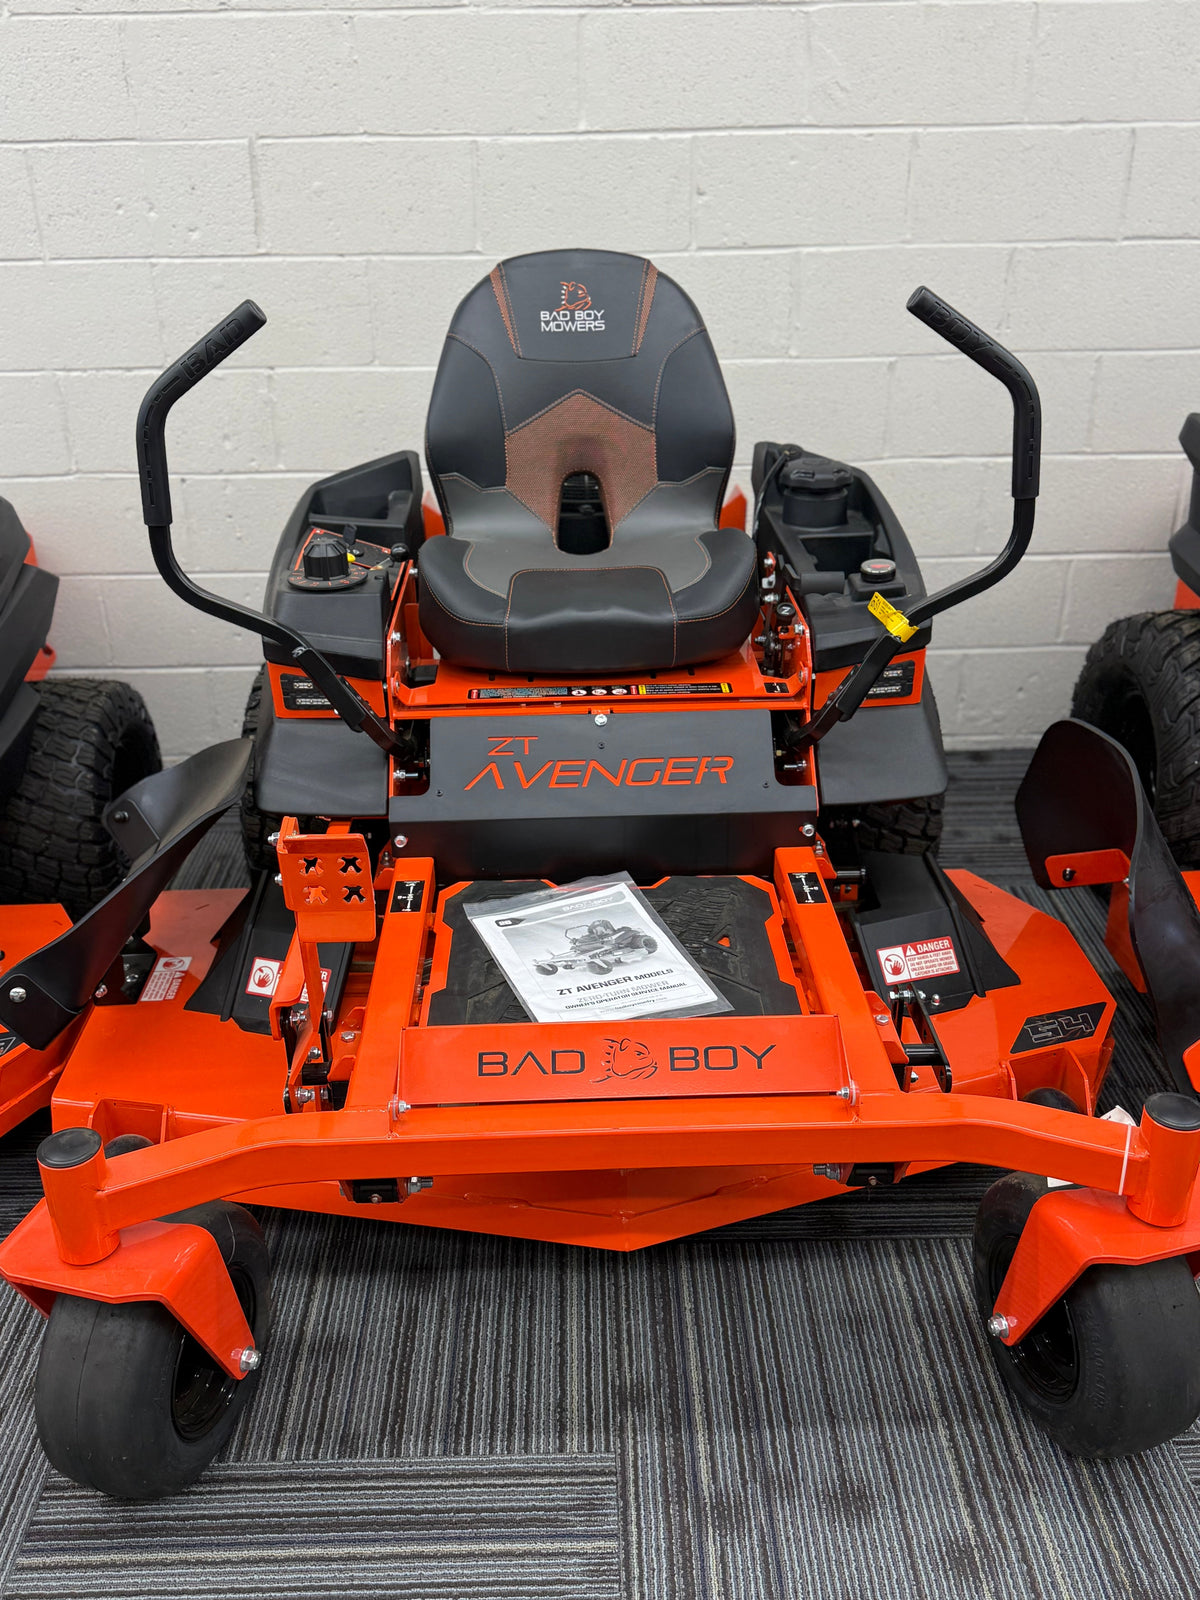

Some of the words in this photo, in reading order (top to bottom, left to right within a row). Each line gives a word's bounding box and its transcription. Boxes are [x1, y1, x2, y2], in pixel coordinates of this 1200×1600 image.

[540, 310, 570, 321] BAD
[575, 310, 605, 320] BOY
[541, 320, 605, 332] MOWERS
[180, 318, 245, 379] BAD
[487, 736, 539, 756] ZT
[464, 756, 734, 791] AVENGER
[916, 939, 951, 953] DANGER
[556, 988, 573, 996] ZT
[576, 976, 633, 993] AVENGER
[634, 968, 674, 981] MODELS
[1024, 1012, 1095, 1044] 54
[477, 1049, 586, 1077] BAD
[669, 1044, 777, 1072] BOY
